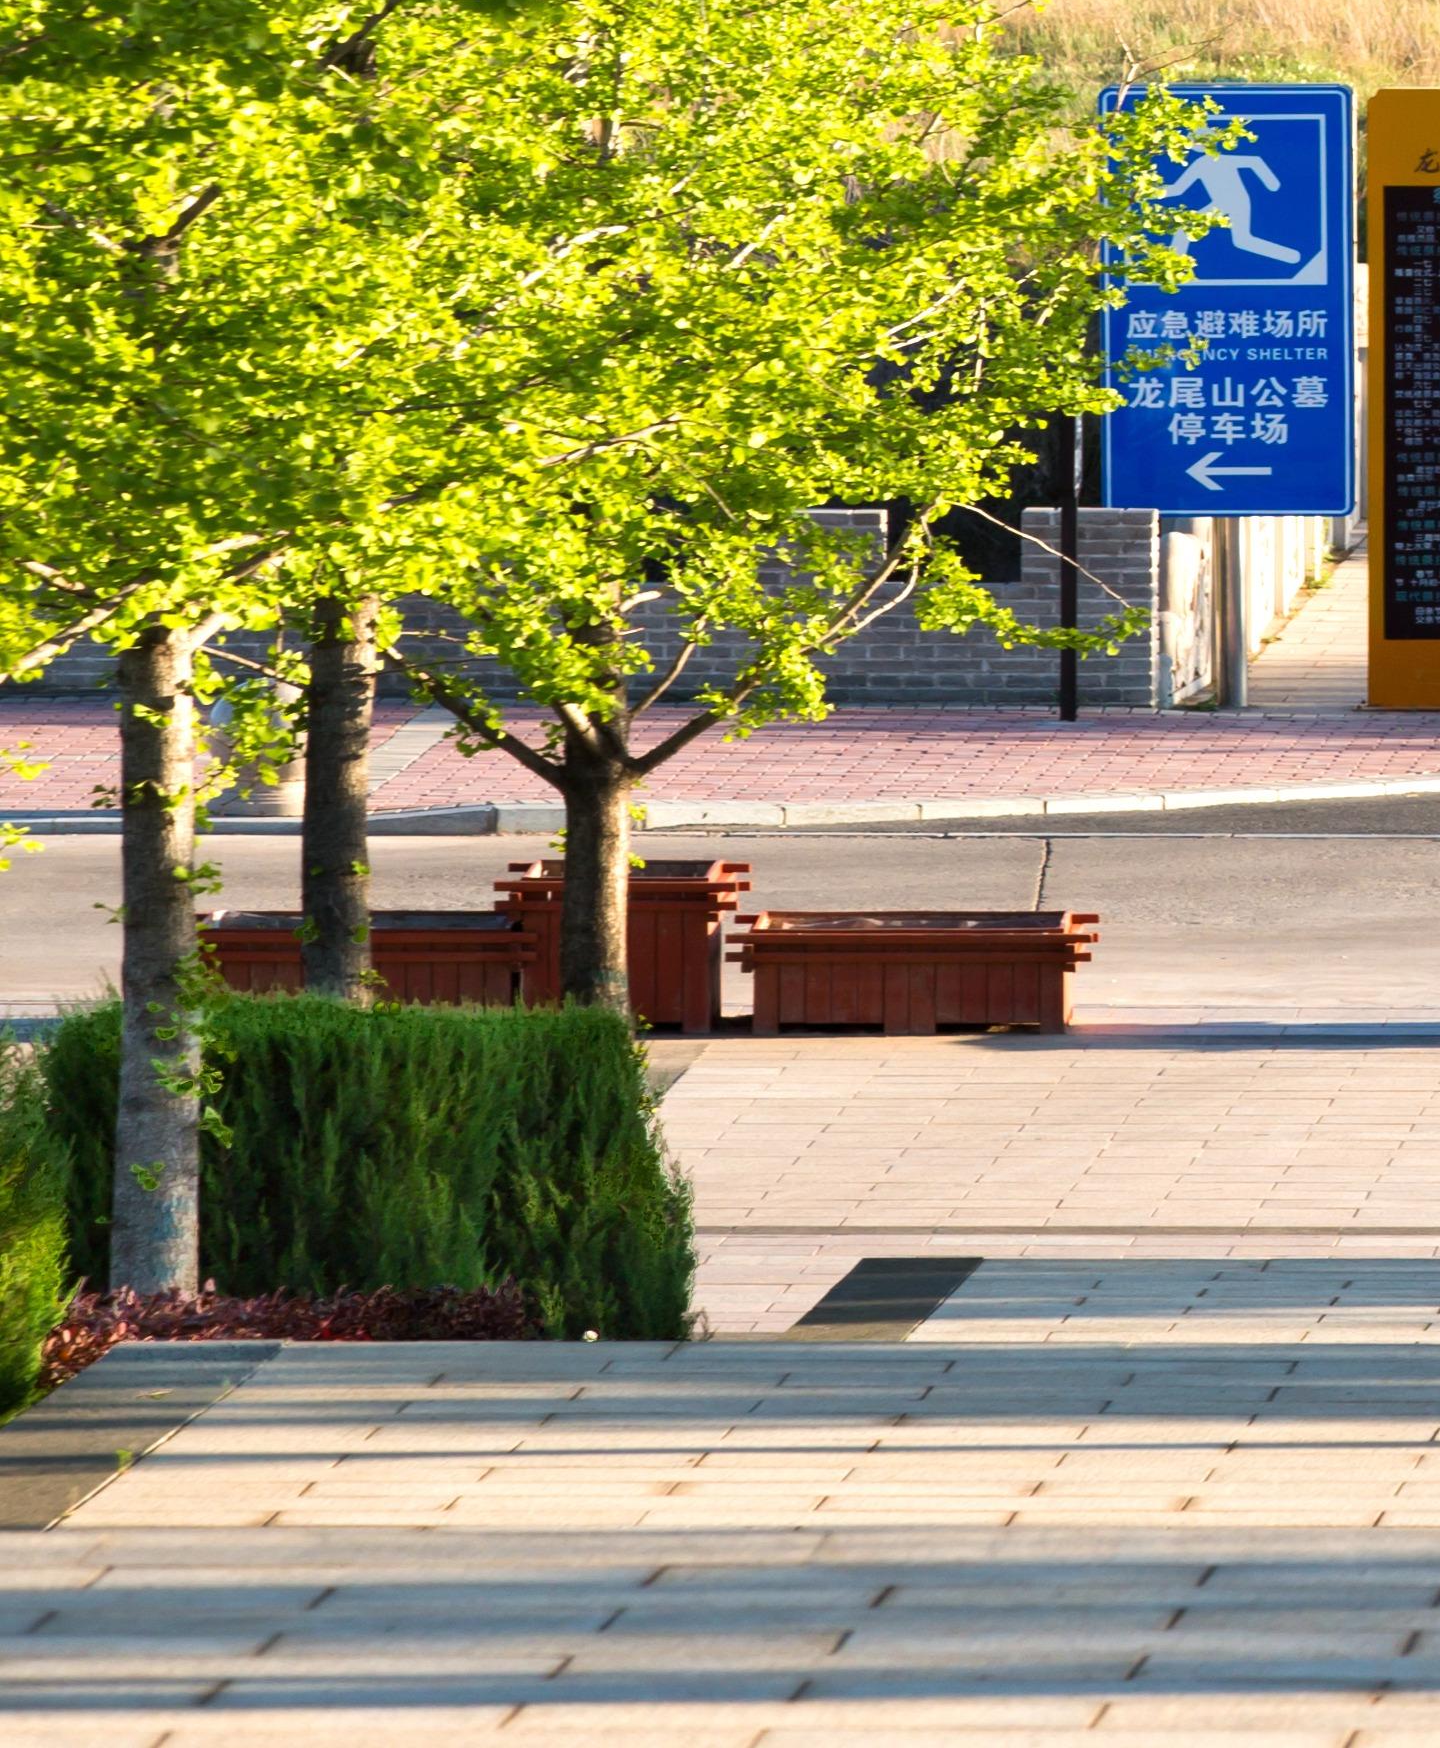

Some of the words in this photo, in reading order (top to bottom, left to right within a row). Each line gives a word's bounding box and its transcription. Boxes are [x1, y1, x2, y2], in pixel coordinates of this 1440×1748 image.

[1126, 309, 1328, 340] 应急避难场所
[1247, 348, 1328, 361] SHELTER
[1128, 375, 1329, 409] 龙尾山公墓
[1167, 412, 1289, 445] 停车场
